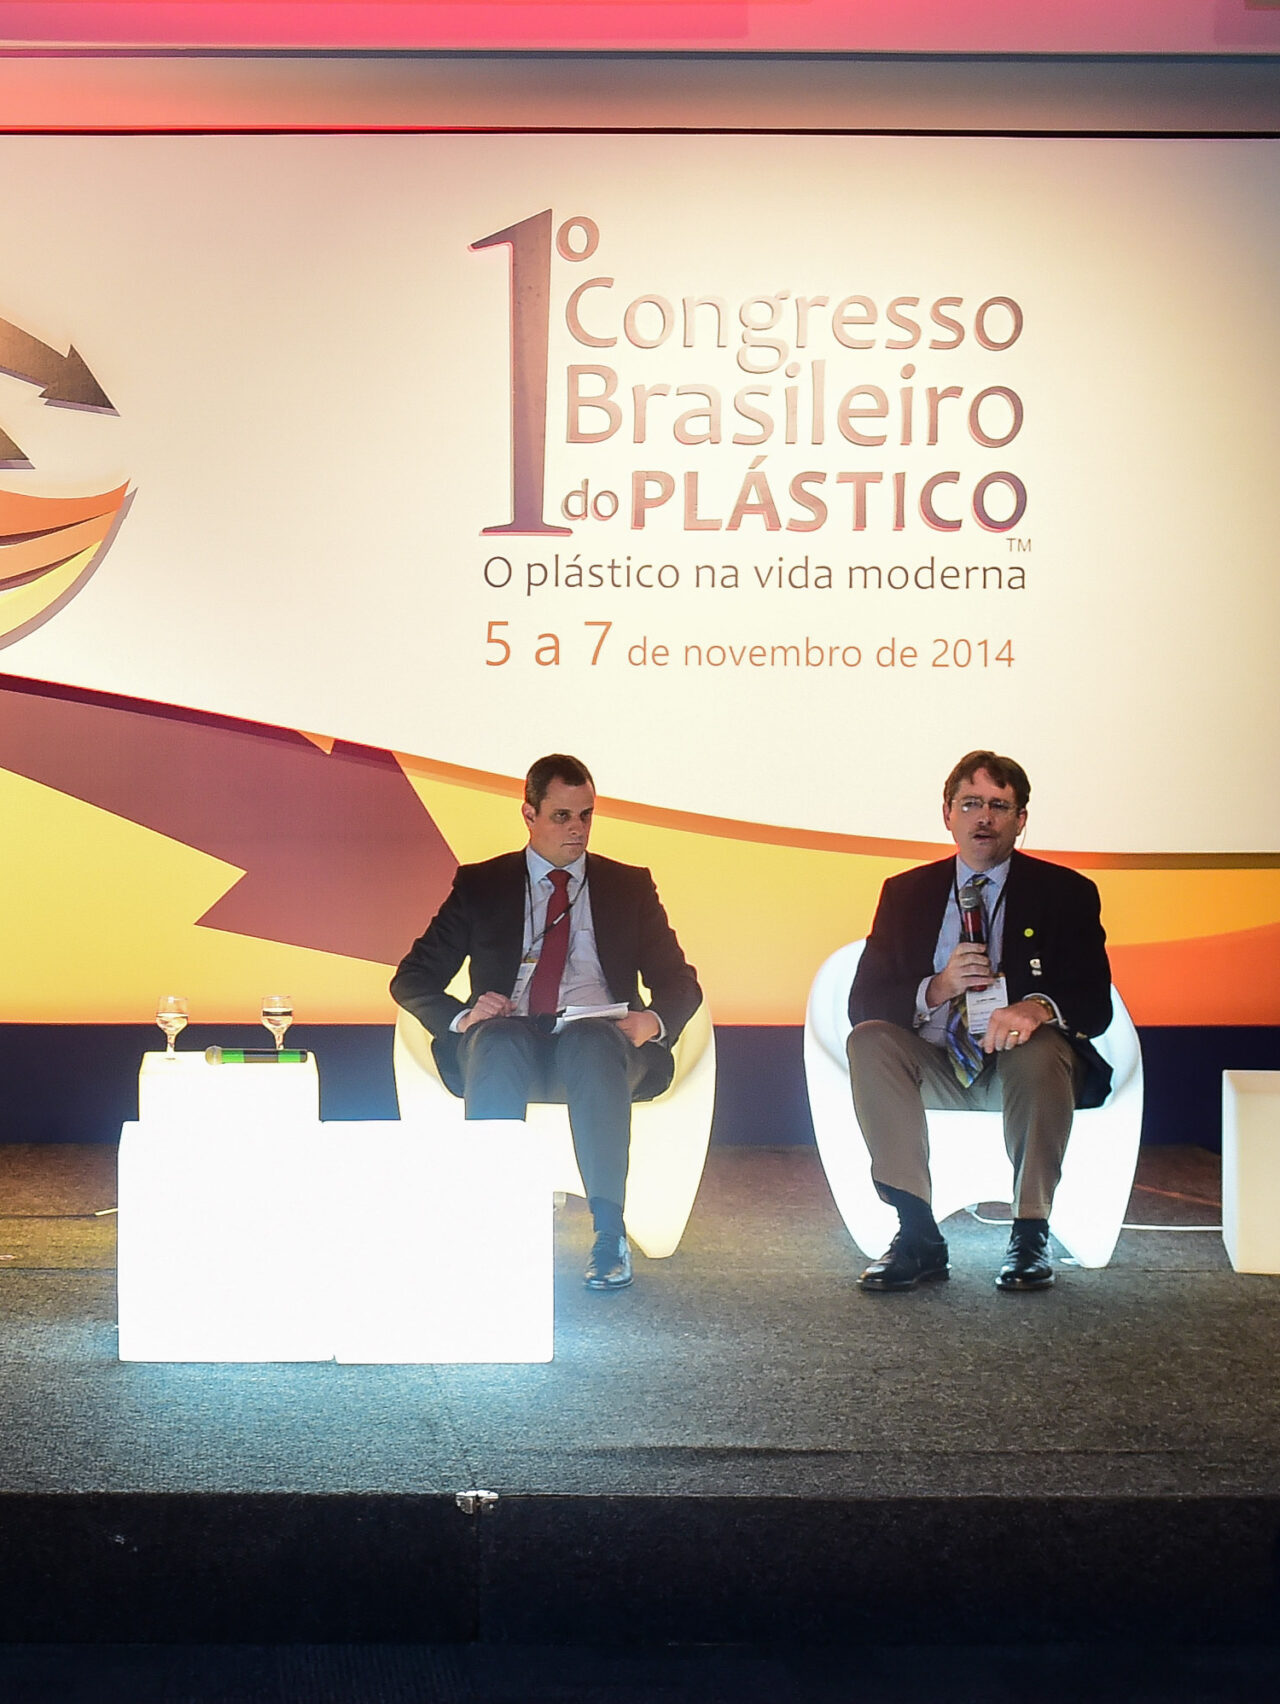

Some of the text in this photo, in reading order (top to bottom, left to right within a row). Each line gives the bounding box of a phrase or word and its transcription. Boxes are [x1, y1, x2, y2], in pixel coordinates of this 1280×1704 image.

[565, 276, 1024, 374] Congresso
[565, 359, 1024, 448] Brasileiro
[560, 455, 1027, 533] do PLÁSTICO
[483, 553, 1027, 596] O plástico na vida moderna
[1006, 537, 1032, 552] TM
[485, 620, 1015, 668] 5 a 7 de novembro de 2014
